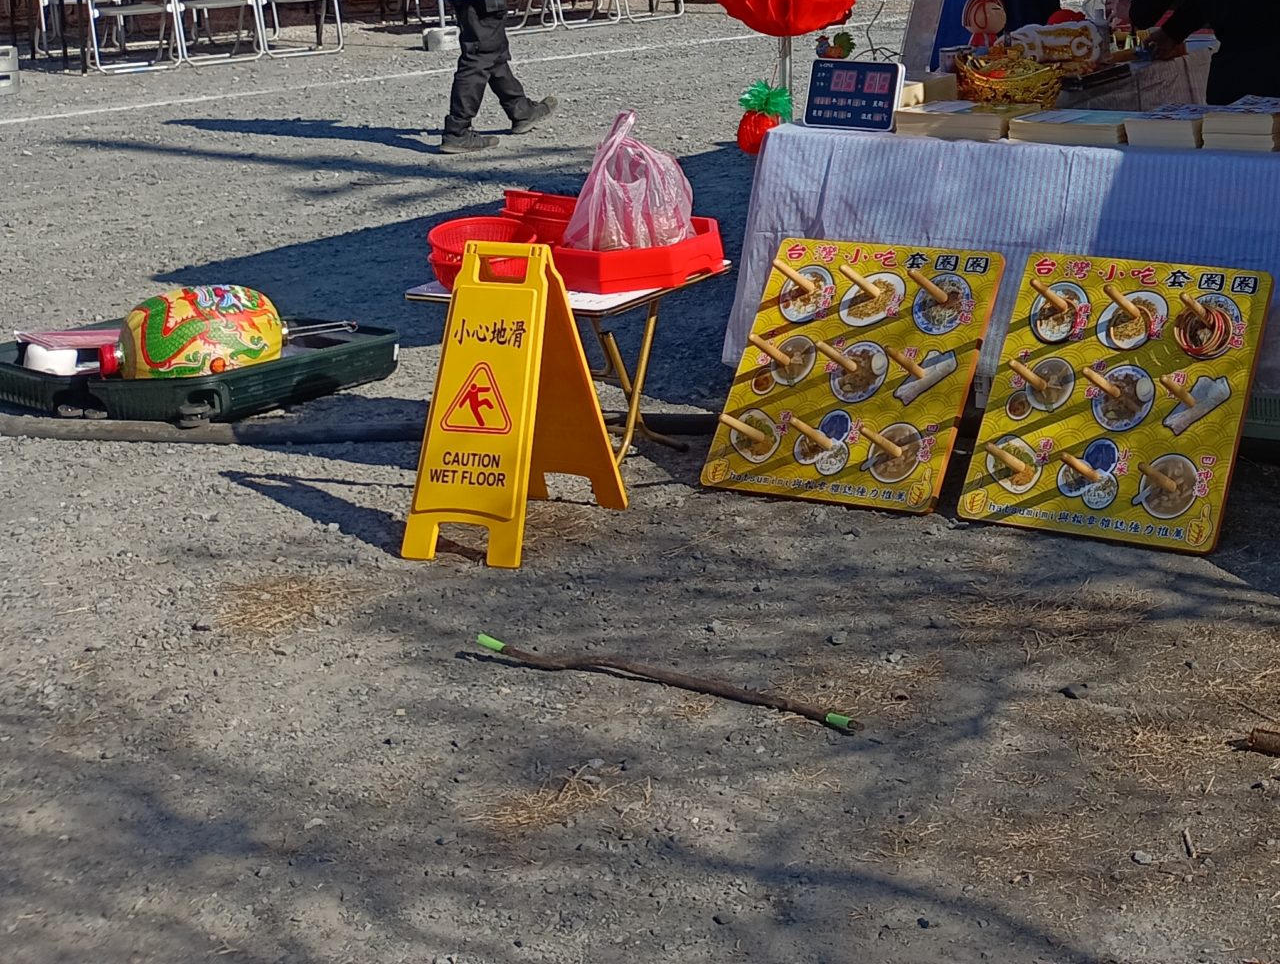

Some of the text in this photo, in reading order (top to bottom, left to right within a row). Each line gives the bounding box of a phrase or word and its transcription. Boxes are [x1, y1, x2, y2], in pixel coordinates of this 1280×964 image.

[454, 318, 526, 349] 小心地滑
[442, 451, 500, 468] CAUTION
[430, 469, 506, 487] WET FLOOR
